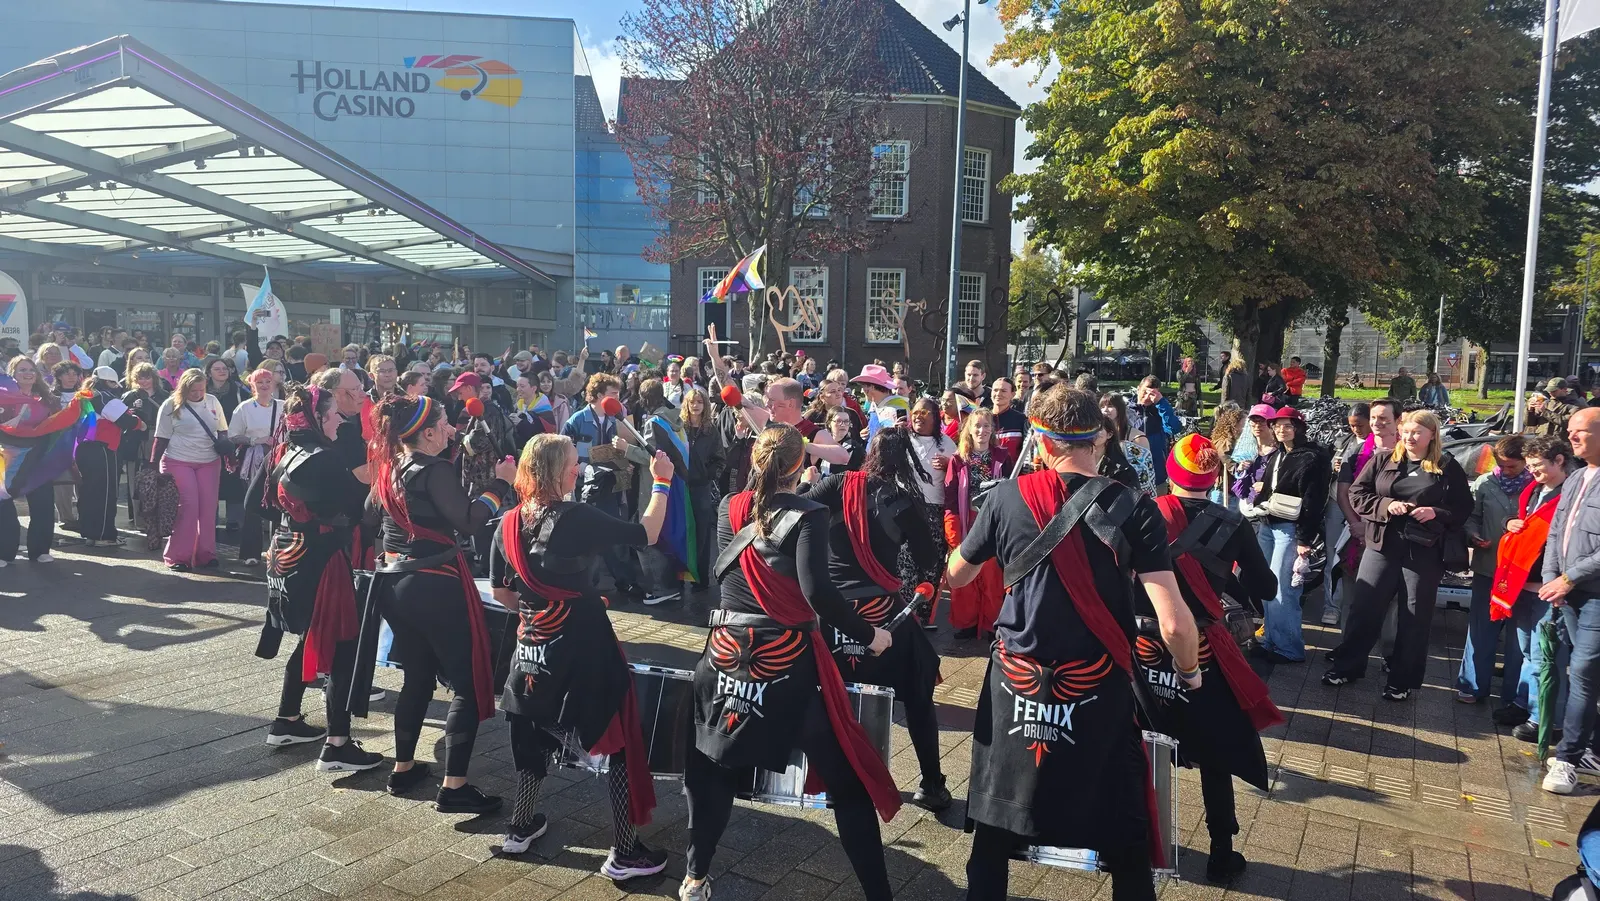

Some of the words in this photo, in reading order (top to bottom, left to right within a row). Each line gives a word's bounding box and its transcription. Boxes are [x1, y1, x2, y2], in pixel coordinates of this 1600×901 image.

[290, 60, 431, 94] HOLLAND
[313, 91, 415, 121] CASINO
[842, 644, 865, 655] DRUMS
[717, 670, 768, 706] FENIX
[1152, 685, 1176, 700] RUMS
[725, 695, 750, 714] DRUMS
[1013, 694, 1076, 731] FENIX
[1024, 723, 1059, 742] DRUMS
